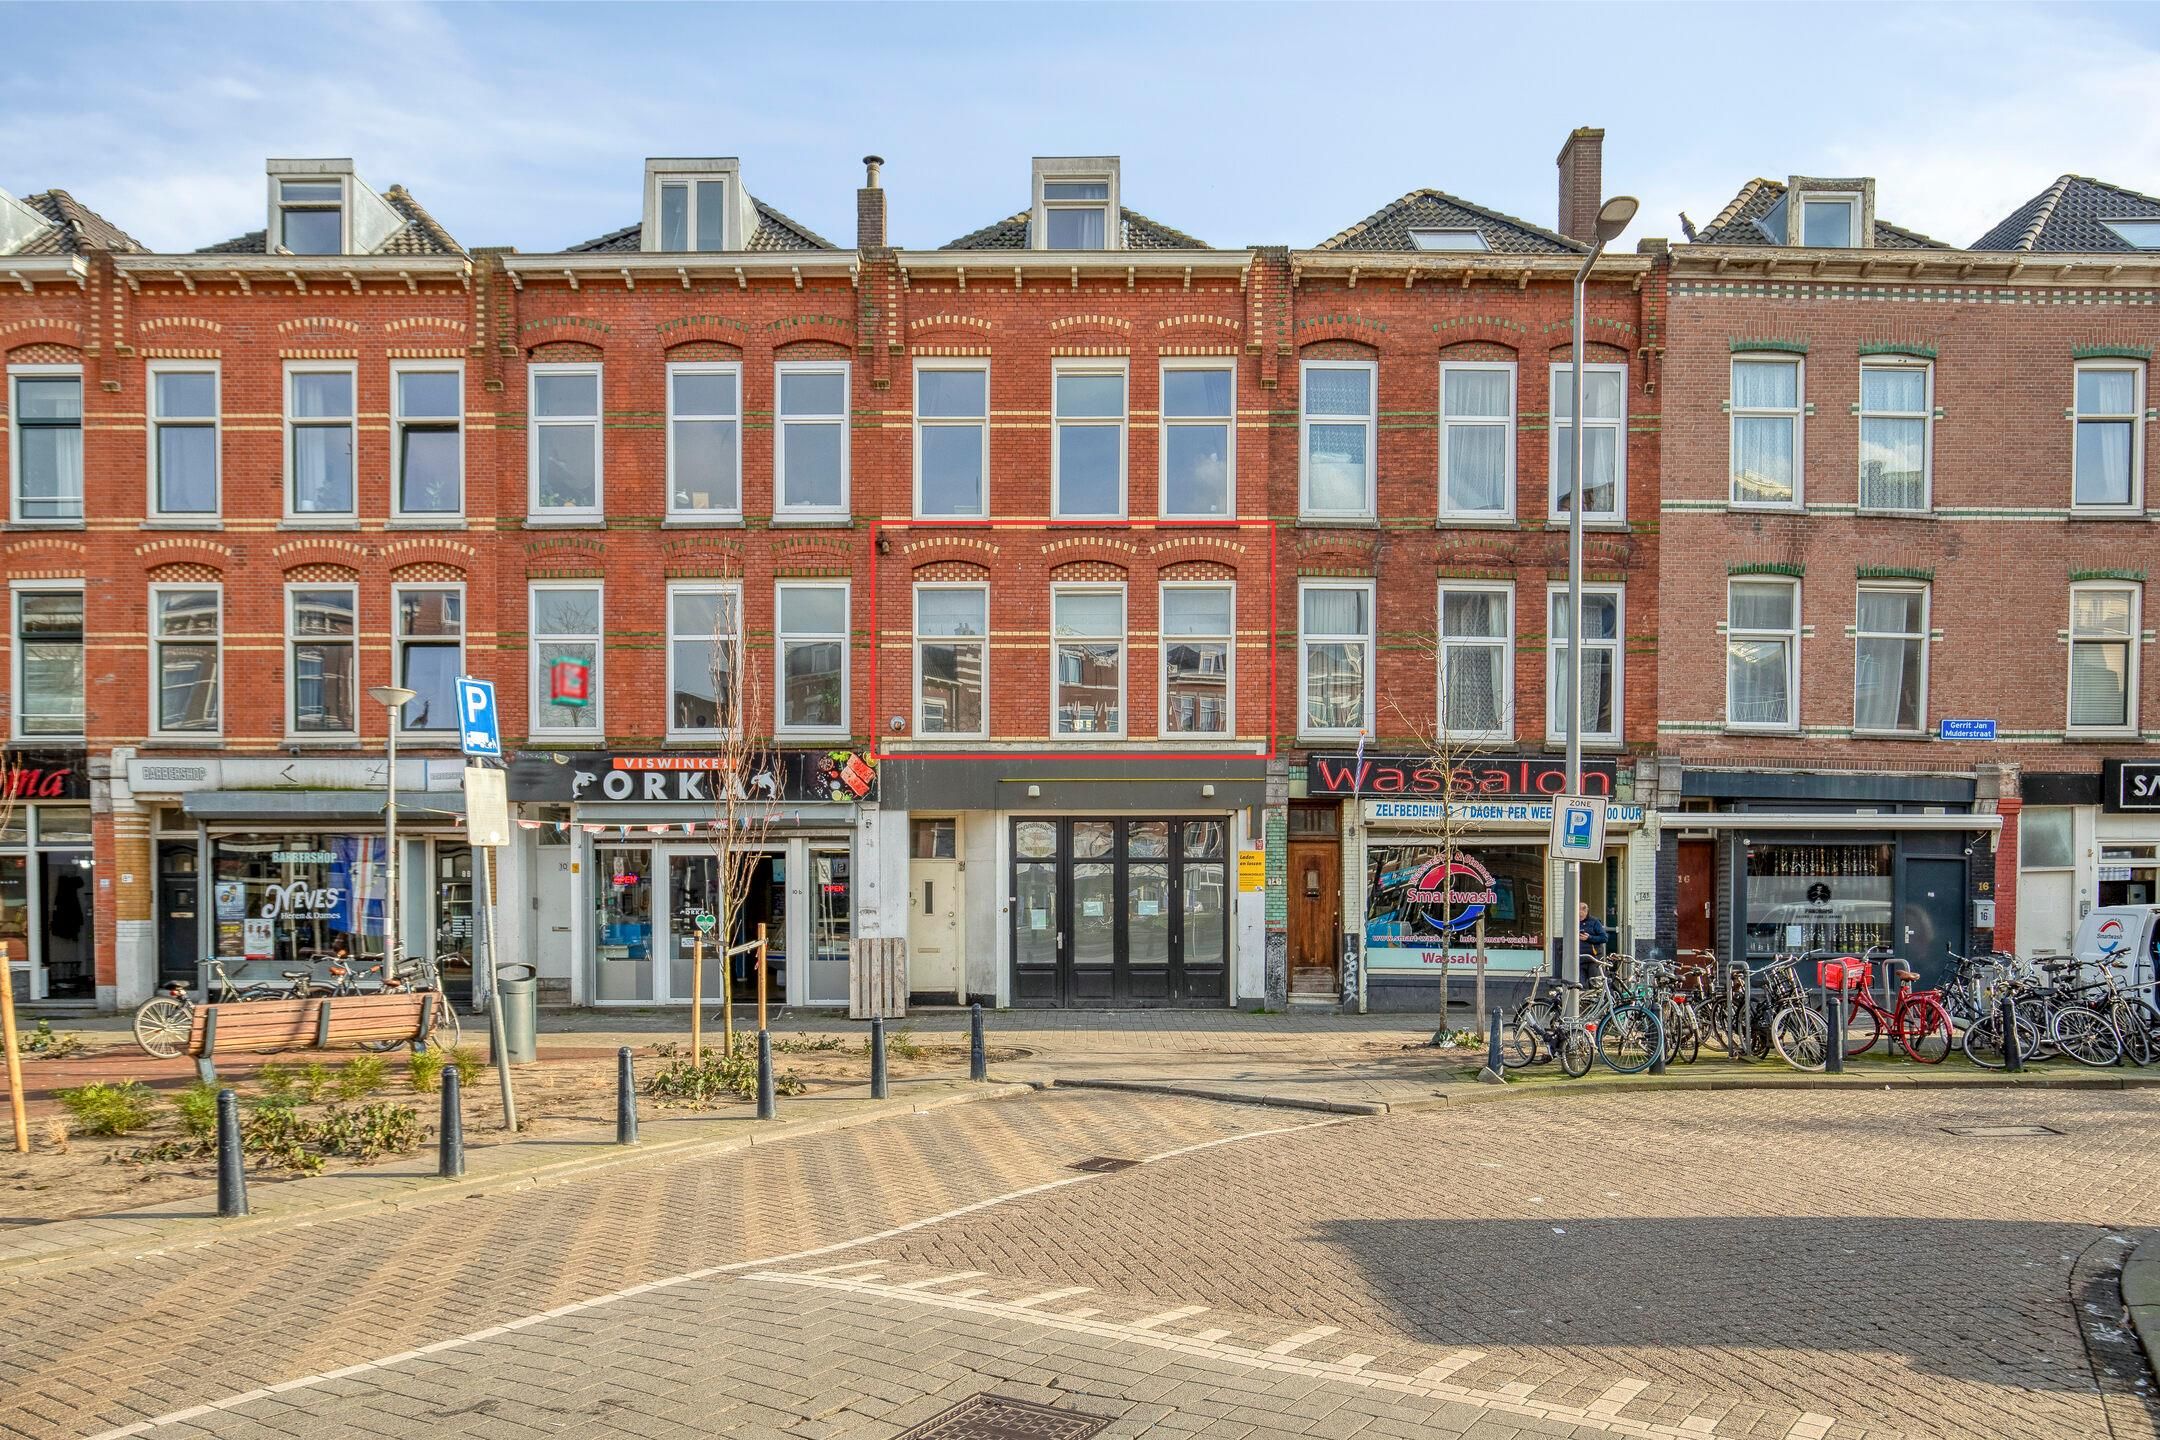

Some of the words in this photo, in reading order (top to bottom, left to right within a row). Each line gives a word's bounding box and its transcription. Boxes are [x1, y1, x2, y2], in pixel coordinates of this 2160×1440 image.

[465, 685, 487, 723] P
[1950, 721, 1972, 729] Gerrit
[1973, 721, 1988, 729] Jan
[1945, 730, 1992, 738] Mulderstraat
[142, 766, 207, 781] BARBERSHOP
[1318, 759, 1610, 796] Wassalon
[0, 768, 73, 797] ma
[1569, 799, 1592, 808] ZONE
[1470, 805, 1504, 819] DAGEN
[1507, 807, 1527, 819] PER
[1530, 807, 1552, 820] WEE
[1621, 807, 1643, 820] UUR
[1569, 811, 1588, 834] P
[271, 851, 338, 863] BARBERSHOP
[1978, 881, 1990, 891] 16
[281, 911, 305, 919] Heren
[1372, 934, 1450, 942] www.smart-wash.
[1421, 951, 1488, 965] Wasalo
